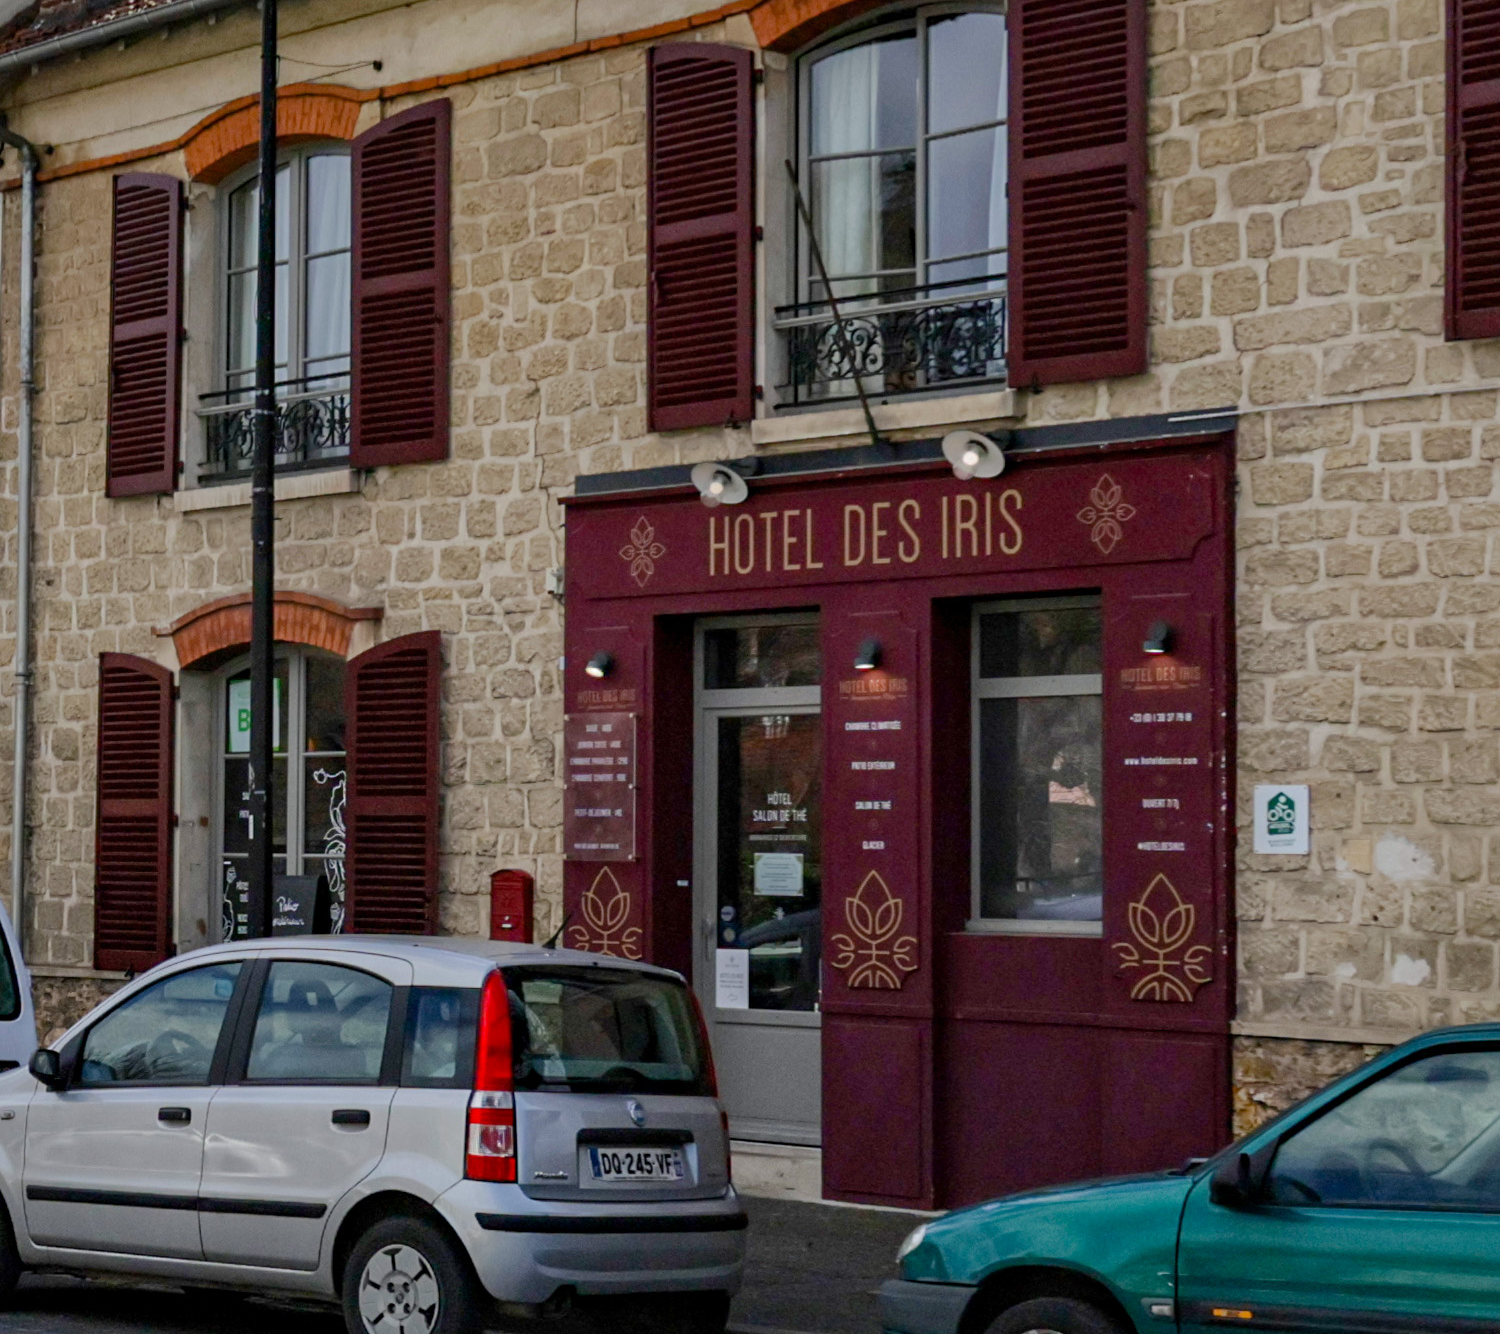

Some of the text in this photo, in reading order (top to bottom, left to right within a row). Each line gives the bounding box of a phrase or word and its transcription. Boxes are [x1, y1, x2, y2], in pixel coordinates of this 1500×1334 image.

[709, 489, 1023, 576] HOTEL DES IRIS
[767, 791, 792, 806] HÔTEL
[752, 808, 807, 822] SALON DE THÉ
[601, 1152, 673, 1175] DQ-245-VF
